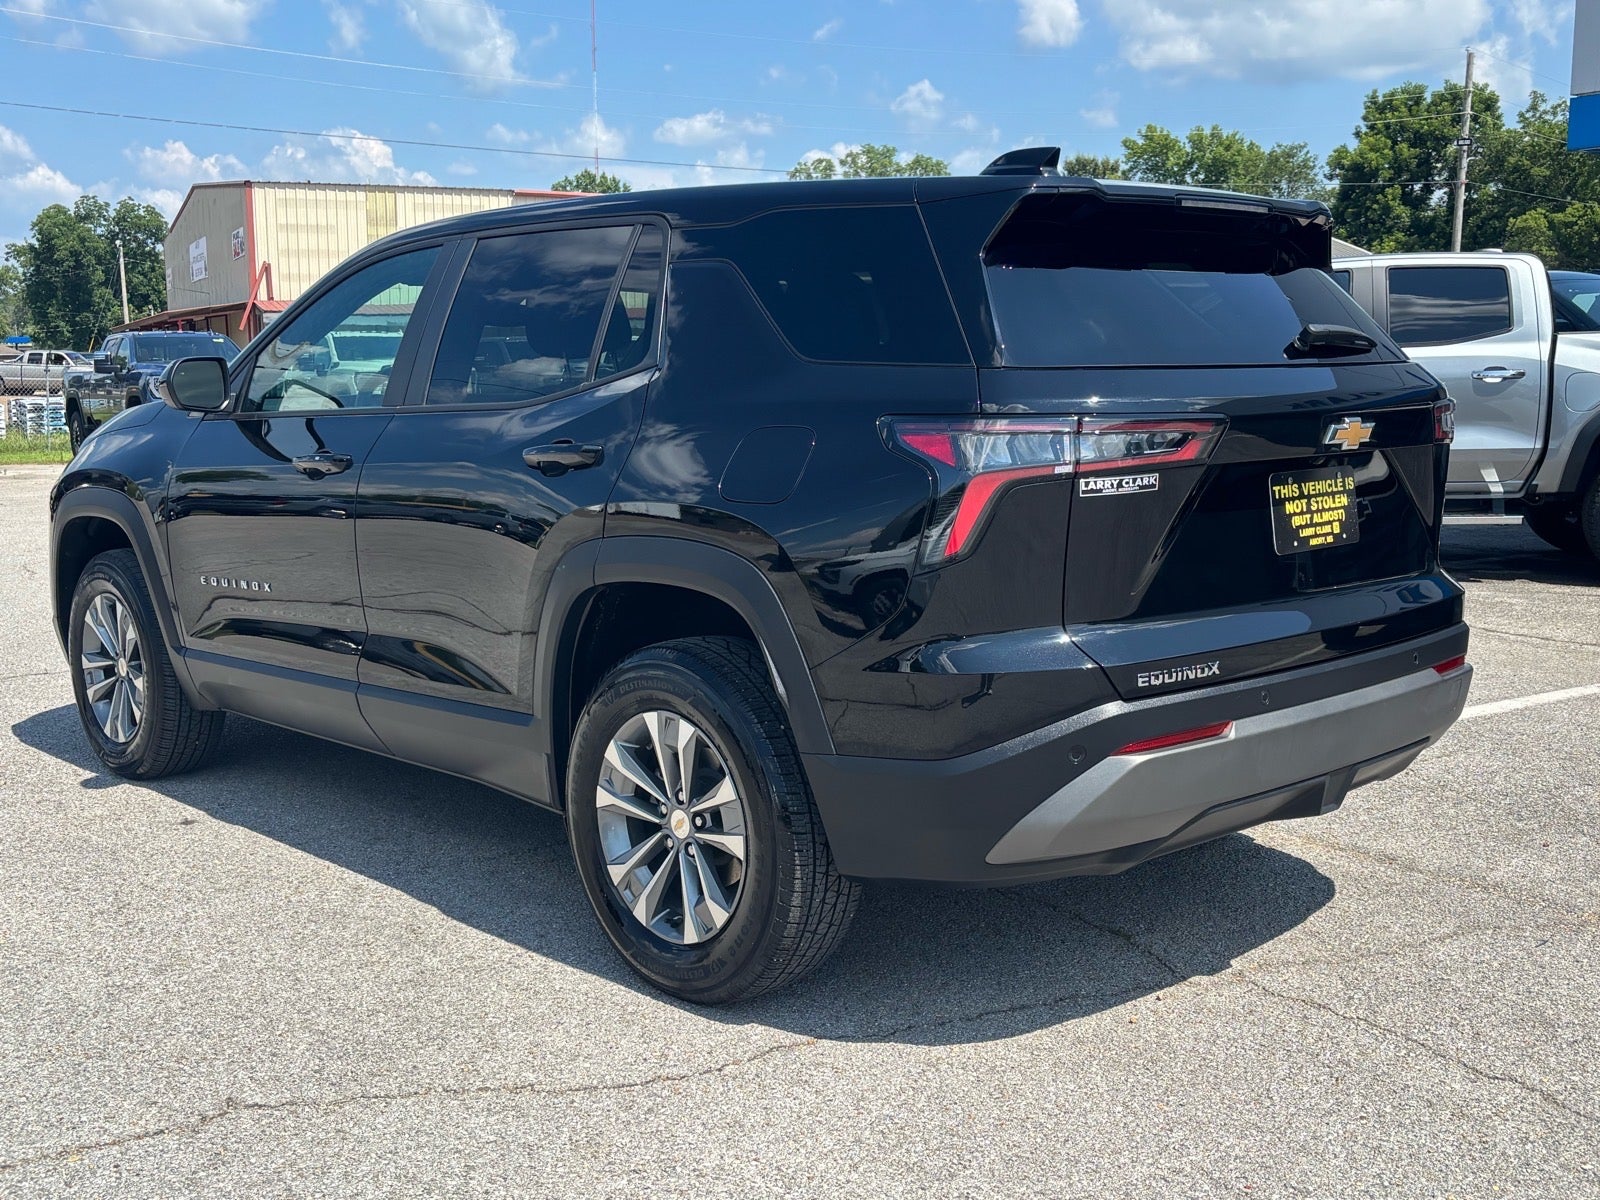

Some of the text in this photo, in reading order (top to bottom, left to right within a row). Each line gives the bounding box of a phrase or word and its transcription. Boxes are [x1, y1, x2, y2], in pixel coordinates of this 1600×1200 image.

[1081, 475, 1157, 491] LARRY CLARK
[1272, 477, 1354, 499] THIS VEHICLE IS
[1285, 494, 1348, 514] NOT STOLEN
[1291, 509, 1346, 529] (BUT ALMOST)
[1299, 525, 1332, 537] LARRY CLARK
[200, 575, 272, 593] EQUINOX
[1137, 660, 1220, 687] EQUINOX
[619, 679, 675, 696] DESTINATION
